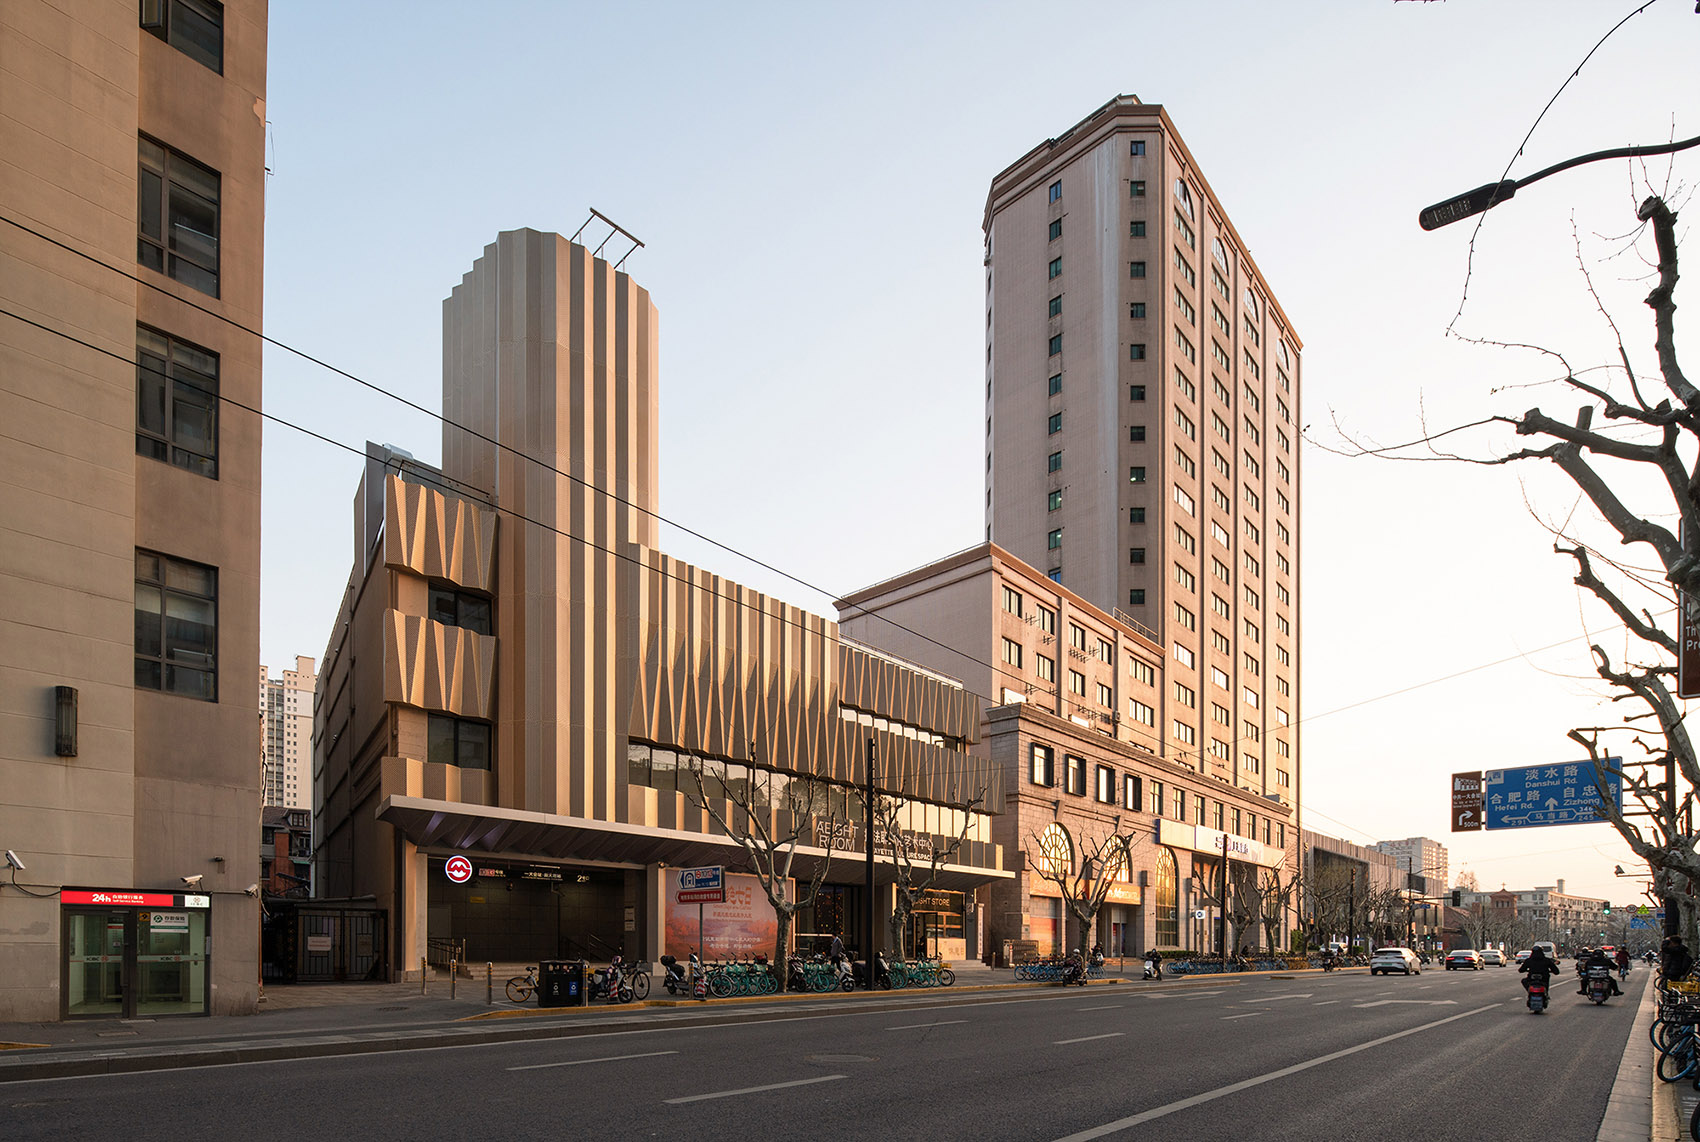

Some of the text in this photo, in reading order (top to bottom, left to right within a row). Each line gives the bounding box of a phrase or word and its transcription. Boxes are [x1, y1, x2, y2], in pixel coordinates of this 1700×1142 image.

[1525, 765, 1579, 780] 淡水路
[1525, 778, 1560, 788] Danshui
[1490, 790, 1541, 804] 合肥路
[1563, 798, 1600, 806] Zizhong
[1494, 804, 1518, 812] Hefei
[816, 820, 858, 838] AEGHT
[92, 893, 111, 902] 24h
[931, 898, 950, 906] STORE
